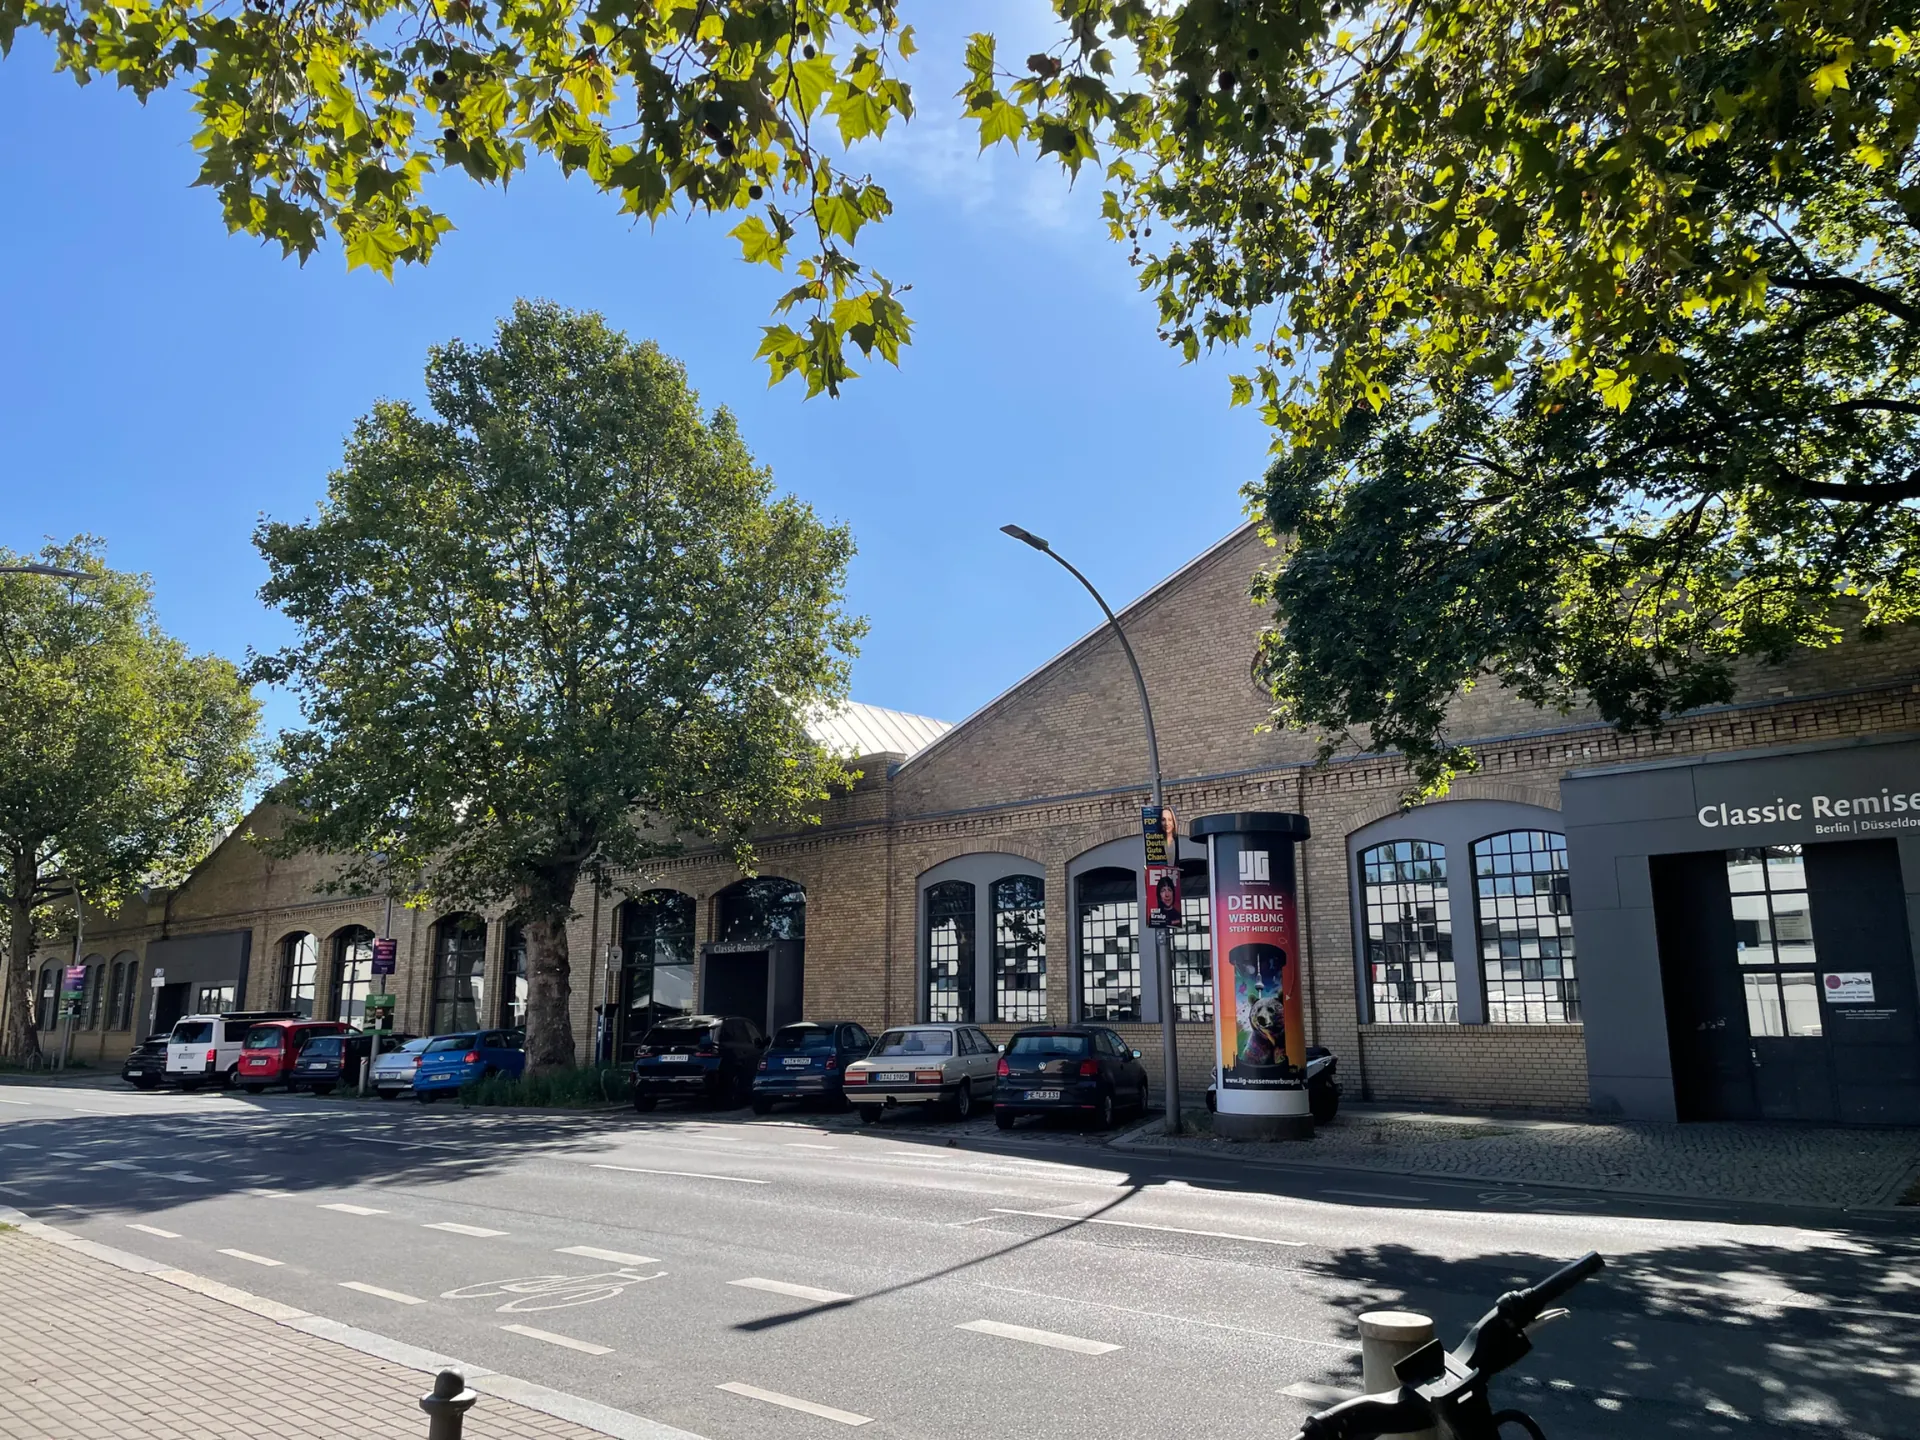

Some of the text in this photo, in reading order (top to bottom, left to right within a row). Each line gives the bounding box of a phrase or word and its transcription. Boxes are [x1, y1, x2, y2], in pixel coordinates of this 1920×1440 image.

[1698, 788, 1920, 828] Classic Remise
[1815, 823, 1850, 834] Berlin
[1228, 894, 1283, 910] DEINE
[1228, 913, 1284, 923] WERBUNG
[713, 942, 761, 953] Classic Remise
